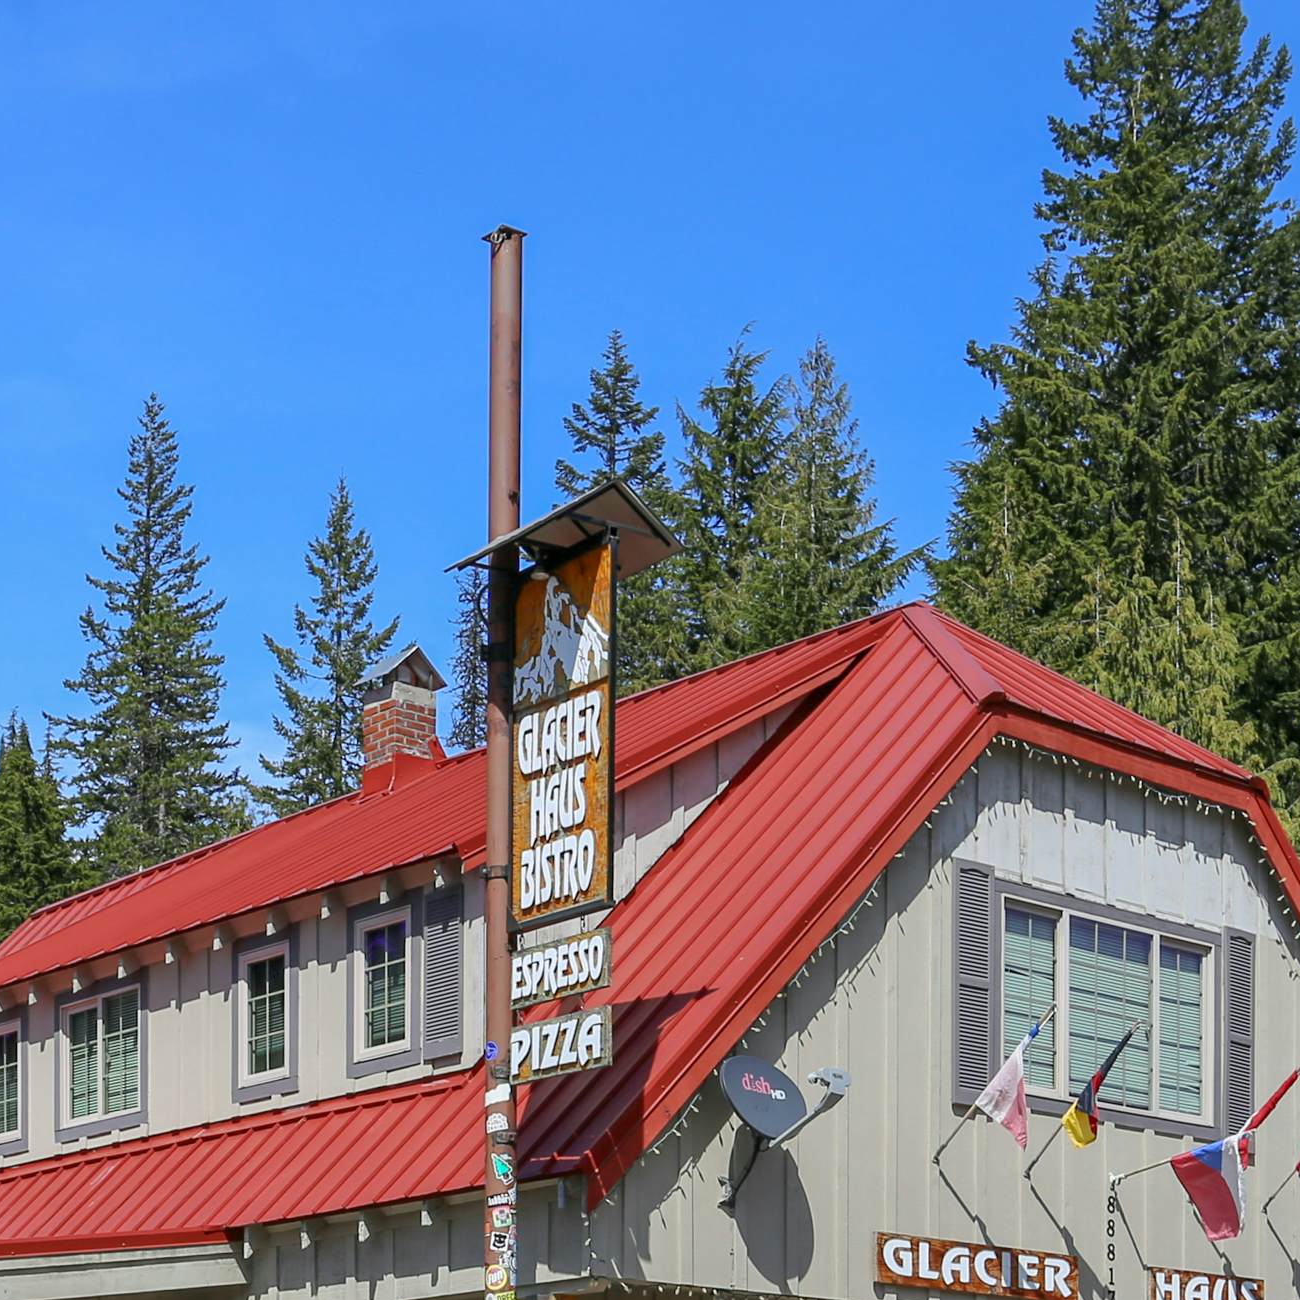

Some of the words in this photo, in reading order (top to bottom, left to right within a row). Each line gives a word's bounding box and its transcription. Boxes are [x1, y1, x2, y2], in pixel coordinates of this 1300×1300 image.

[517, 690, 602, 776] GLACIER
[530, 768, 587, 847] HAUS
[520, 828, 595, 910] BISTRO
[511, 936, 604, 1000] ESPRESSO
[511, 1013, 602, 1075] PIZZA
[742, 1073, 771, 1095] dish
[771, 1089, 786, 1100] HD
[882, 1238, 1073, 1298] GLACIER
